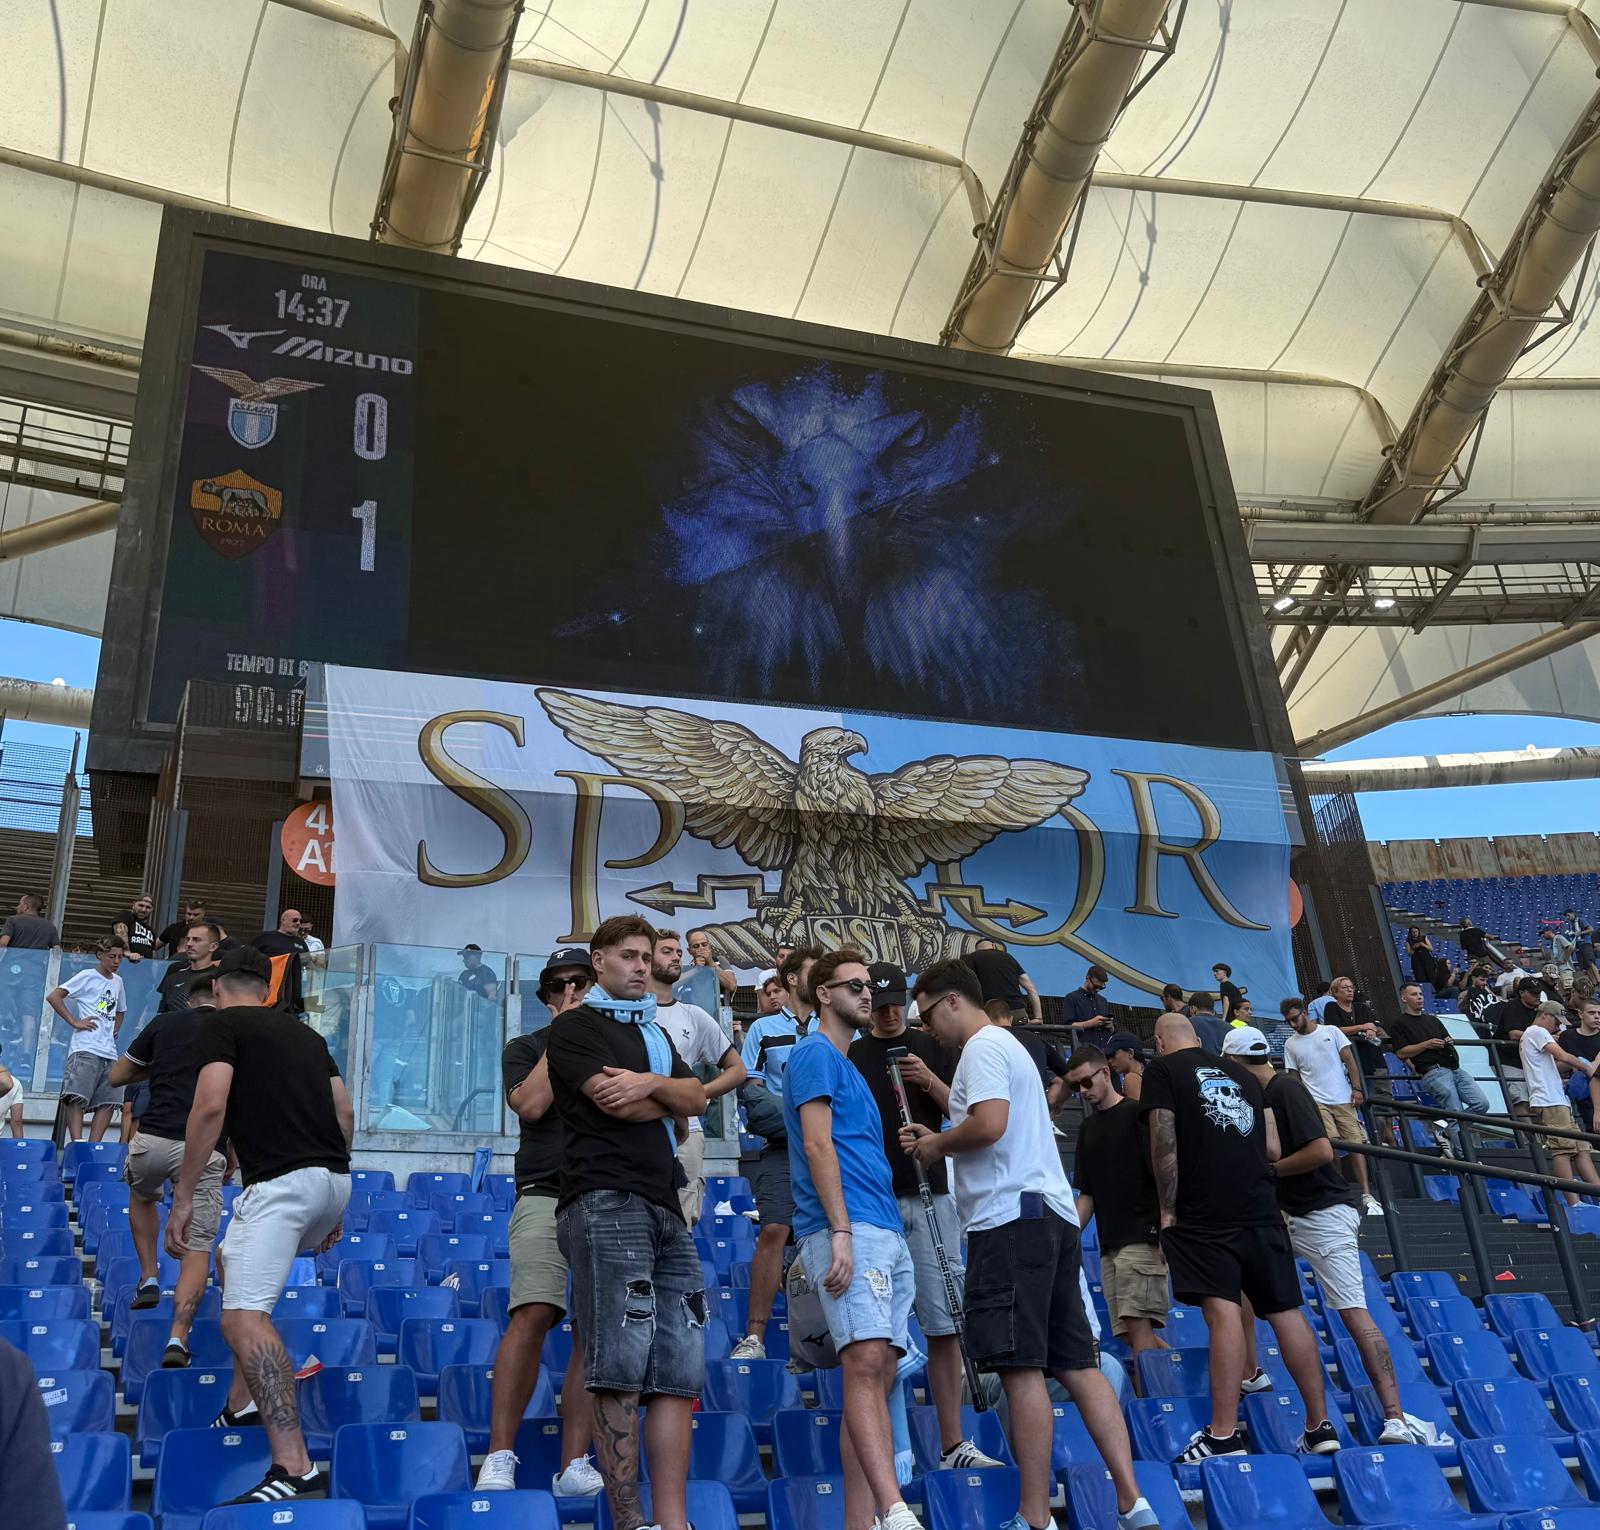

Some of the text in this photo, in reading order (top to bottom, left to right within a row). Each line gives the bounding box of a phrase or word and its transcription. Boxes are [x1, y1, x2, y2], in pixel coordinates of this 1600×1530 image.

[301, 274, 327, 291] ORA
[274, 289, 350, 328] 14:37
[354, 393, 388, 460] 0
[202, 517, 266, 537] ROMA
[352, 500, 377, 571] 1
[227, 653, 274, 674] TEMPO
[279, 658, 295, 676] DI
[305, 804, 335, 836] 4
[814, 918, 901, 966] SSL
